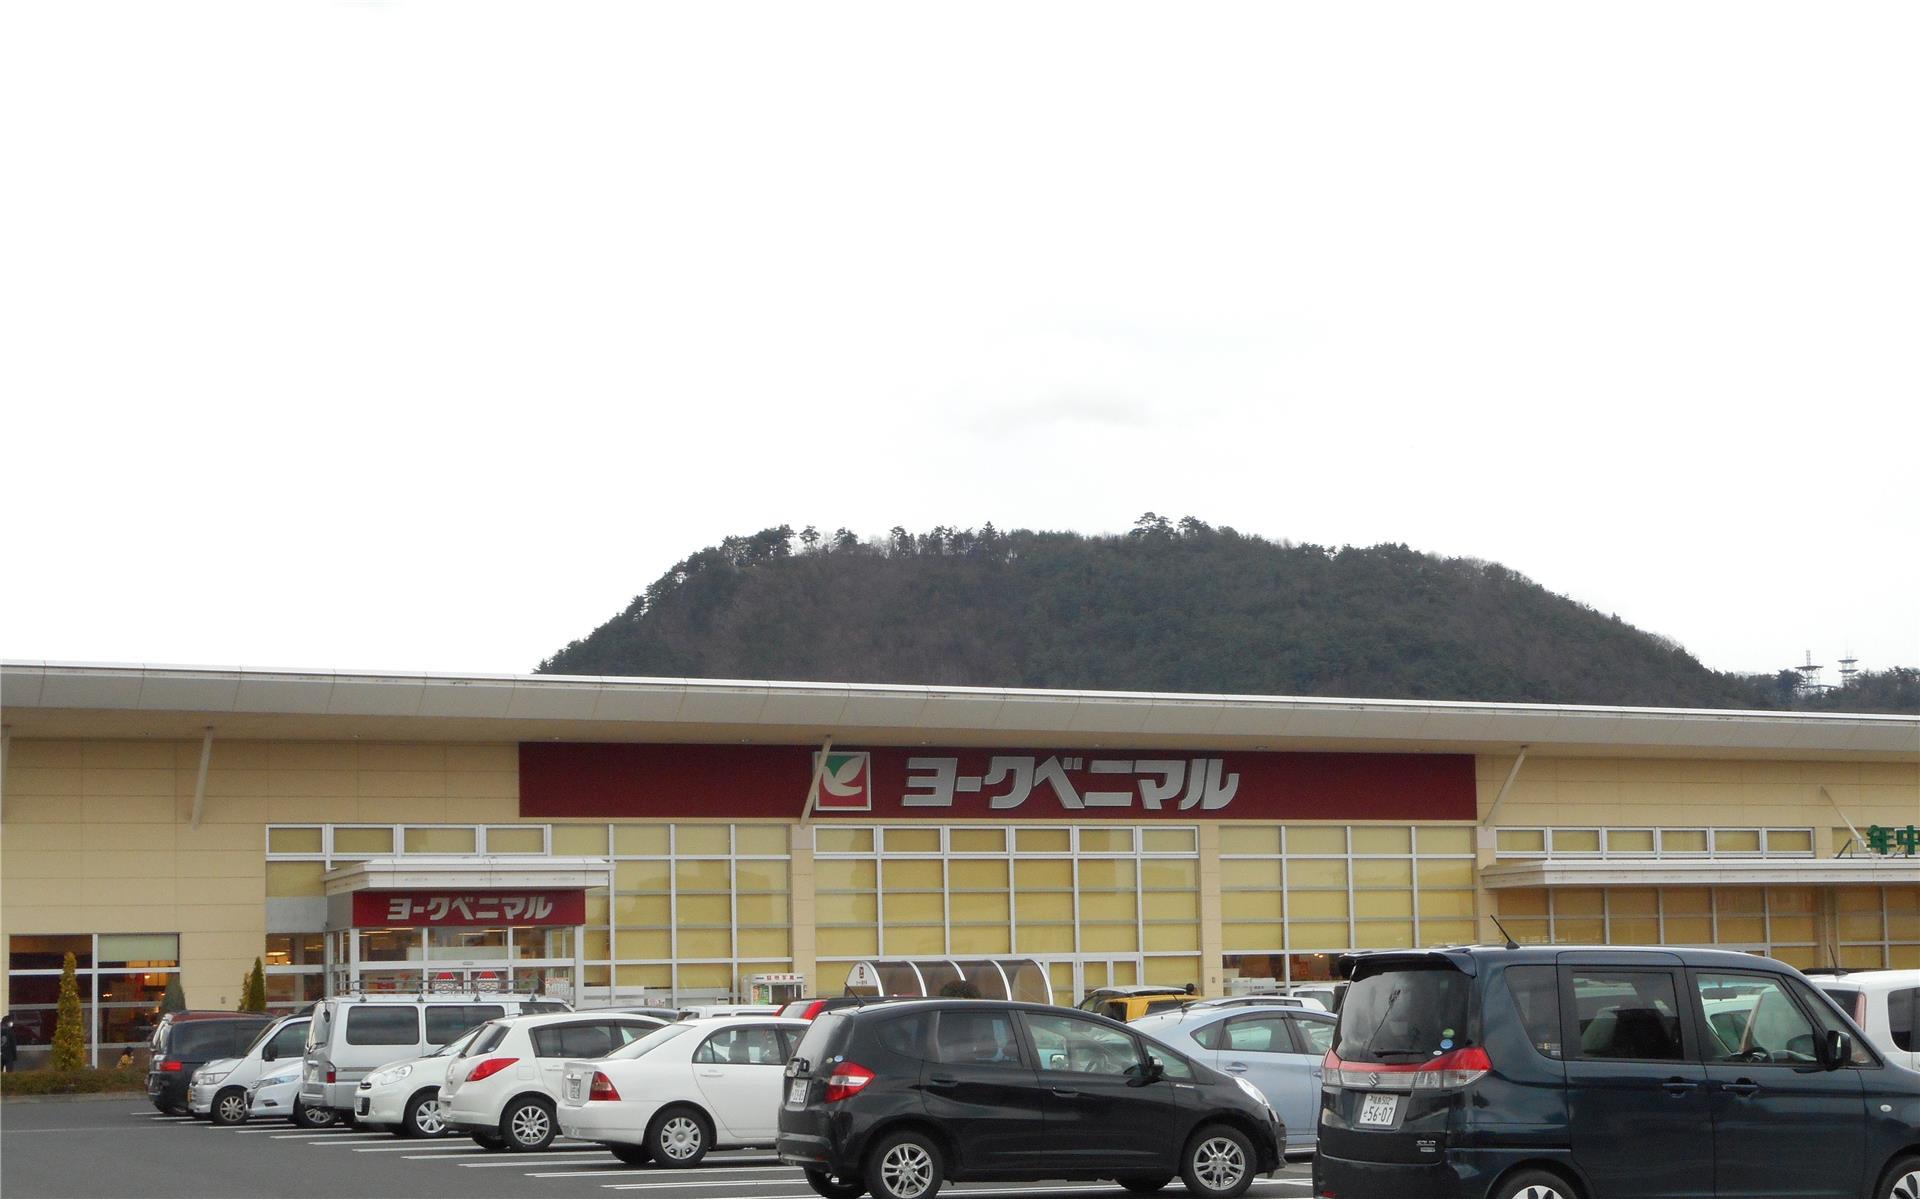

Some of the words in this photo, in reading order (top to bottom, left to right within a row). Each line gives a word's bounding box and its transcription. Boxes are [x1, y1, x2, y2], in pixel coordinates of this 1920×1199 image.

[902, 755, 1240, 809] ヨークベニマル
[387, 896, 553, 920] ヨークベニマル
